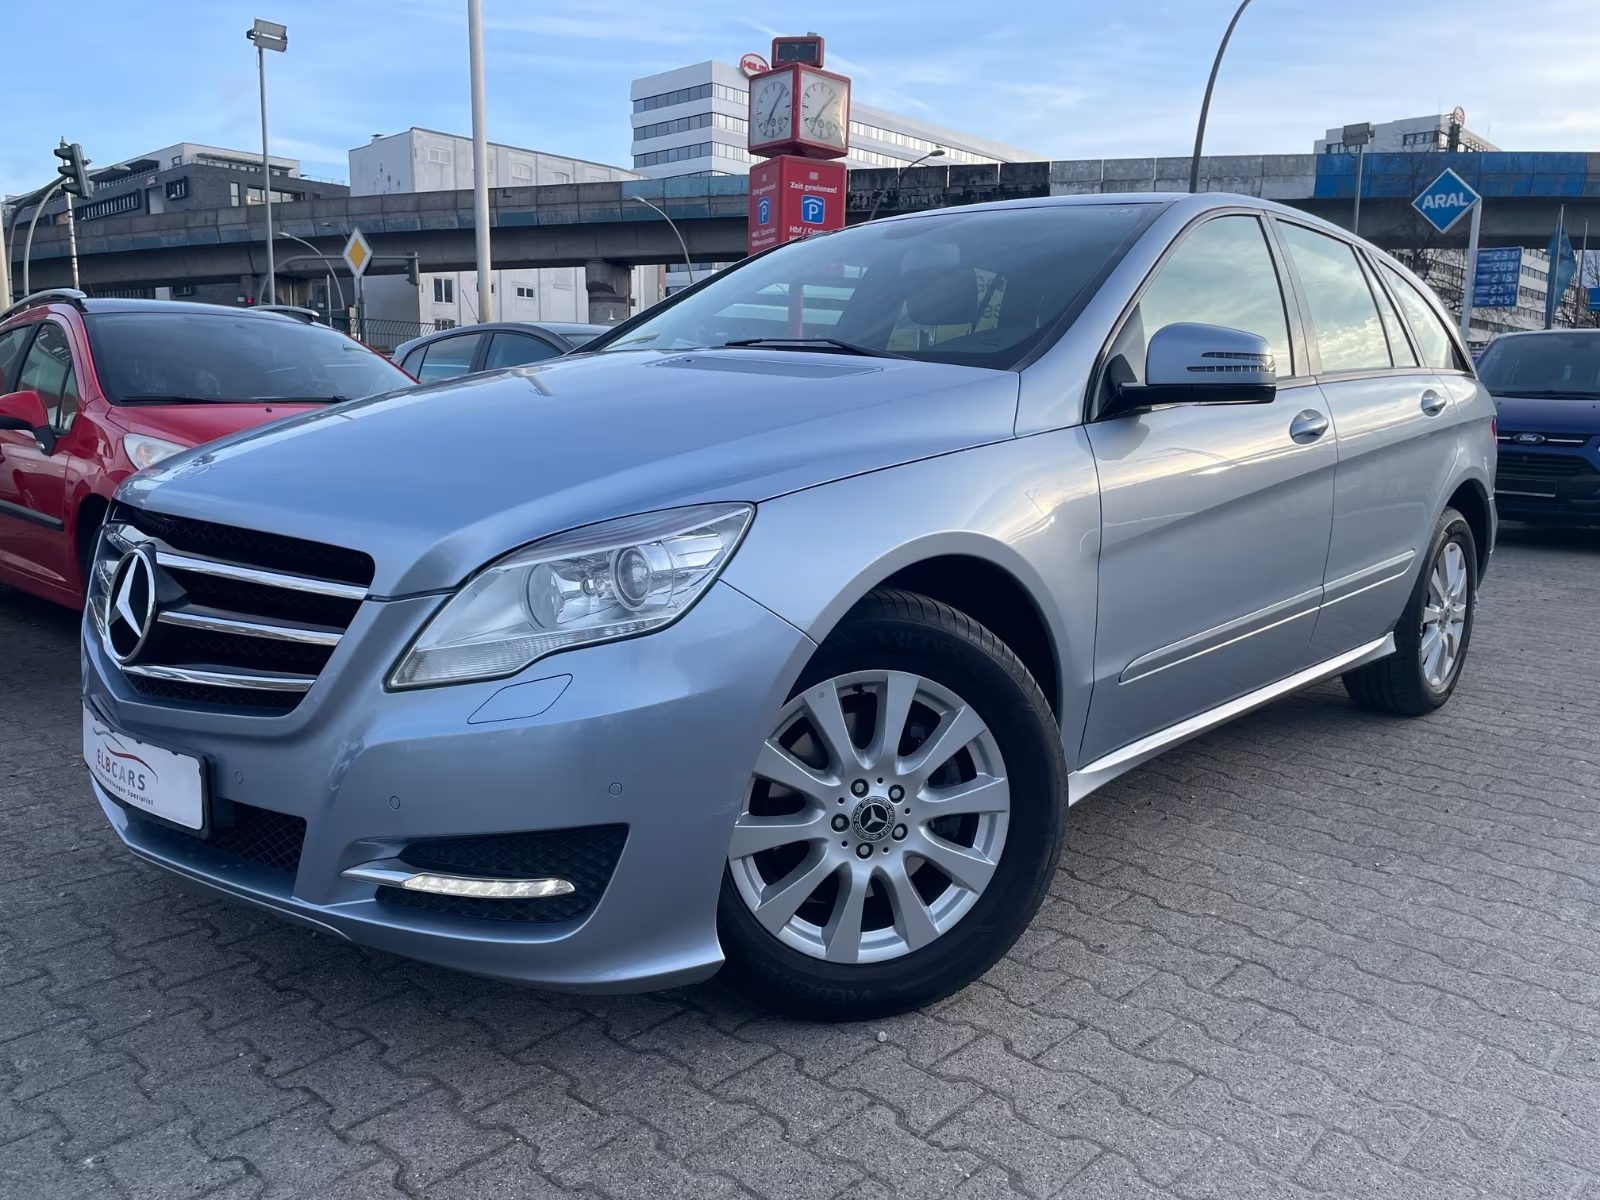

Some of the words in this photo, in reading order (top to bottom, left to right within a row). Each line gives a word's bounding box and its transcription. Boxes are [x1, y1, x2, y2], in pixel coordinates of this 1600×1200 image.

[790, 181, 804, 190] Zeit
[804, 183, 838, 194] gewinnen!
[1421, 192, 1469, 210] ARAL
[808, 203, 819, 220] P
[97, 748, 146, 791] ELBCARS
